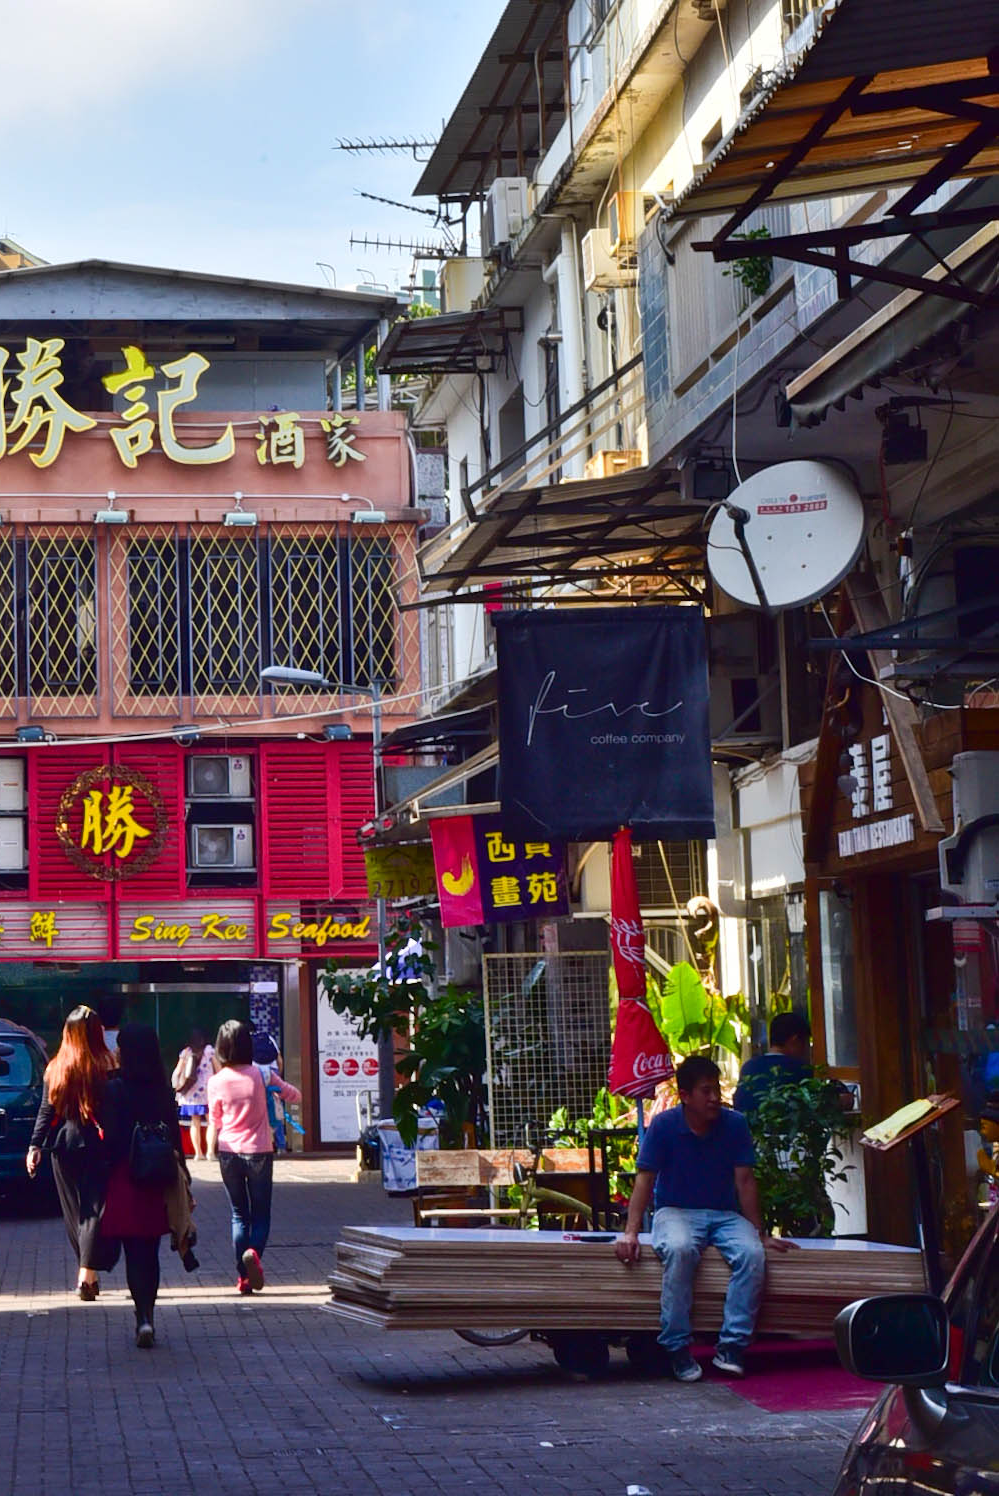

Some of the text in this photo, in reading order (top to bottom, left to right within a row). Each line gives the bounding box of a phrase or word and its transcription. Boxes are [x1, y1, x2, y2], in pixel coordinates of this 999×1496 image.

[255, 413, 368, 469] 酒家
[590, 733, 685, 749] coffee company
[80, 784, 151, 858] 勝
[490, 871, 559, 908] 畫苑
[130, 912, 371, 948] Sing Kee Seafood
